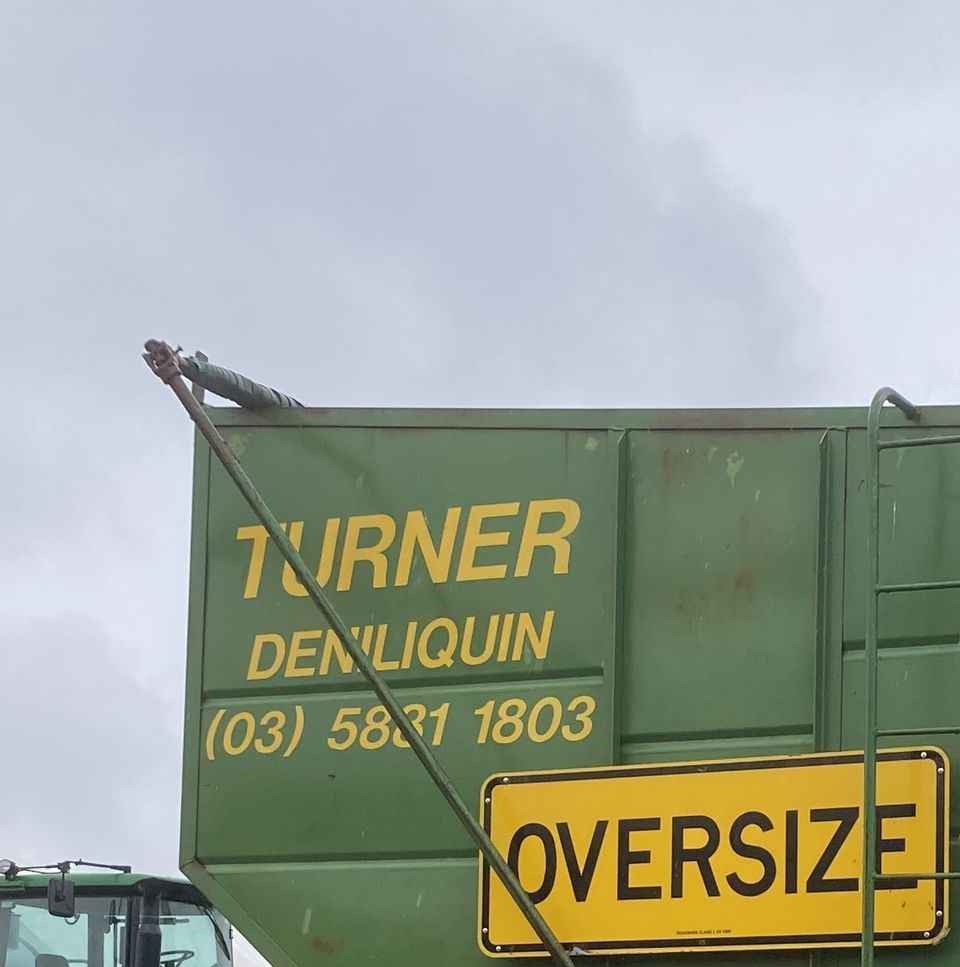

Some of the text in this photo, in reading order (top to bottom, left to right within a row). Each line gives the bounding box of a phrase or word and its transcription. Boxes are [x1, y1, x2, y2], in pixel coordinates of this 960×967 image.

[235, 498, 581, 599] TURNER
[246, 610, 555, 681] DENILIQUIN
[205, 706, 305, 760] (03)
[474, 695, 596, 744] 1803
[507, 803, 918, 905] OVERSIZE
